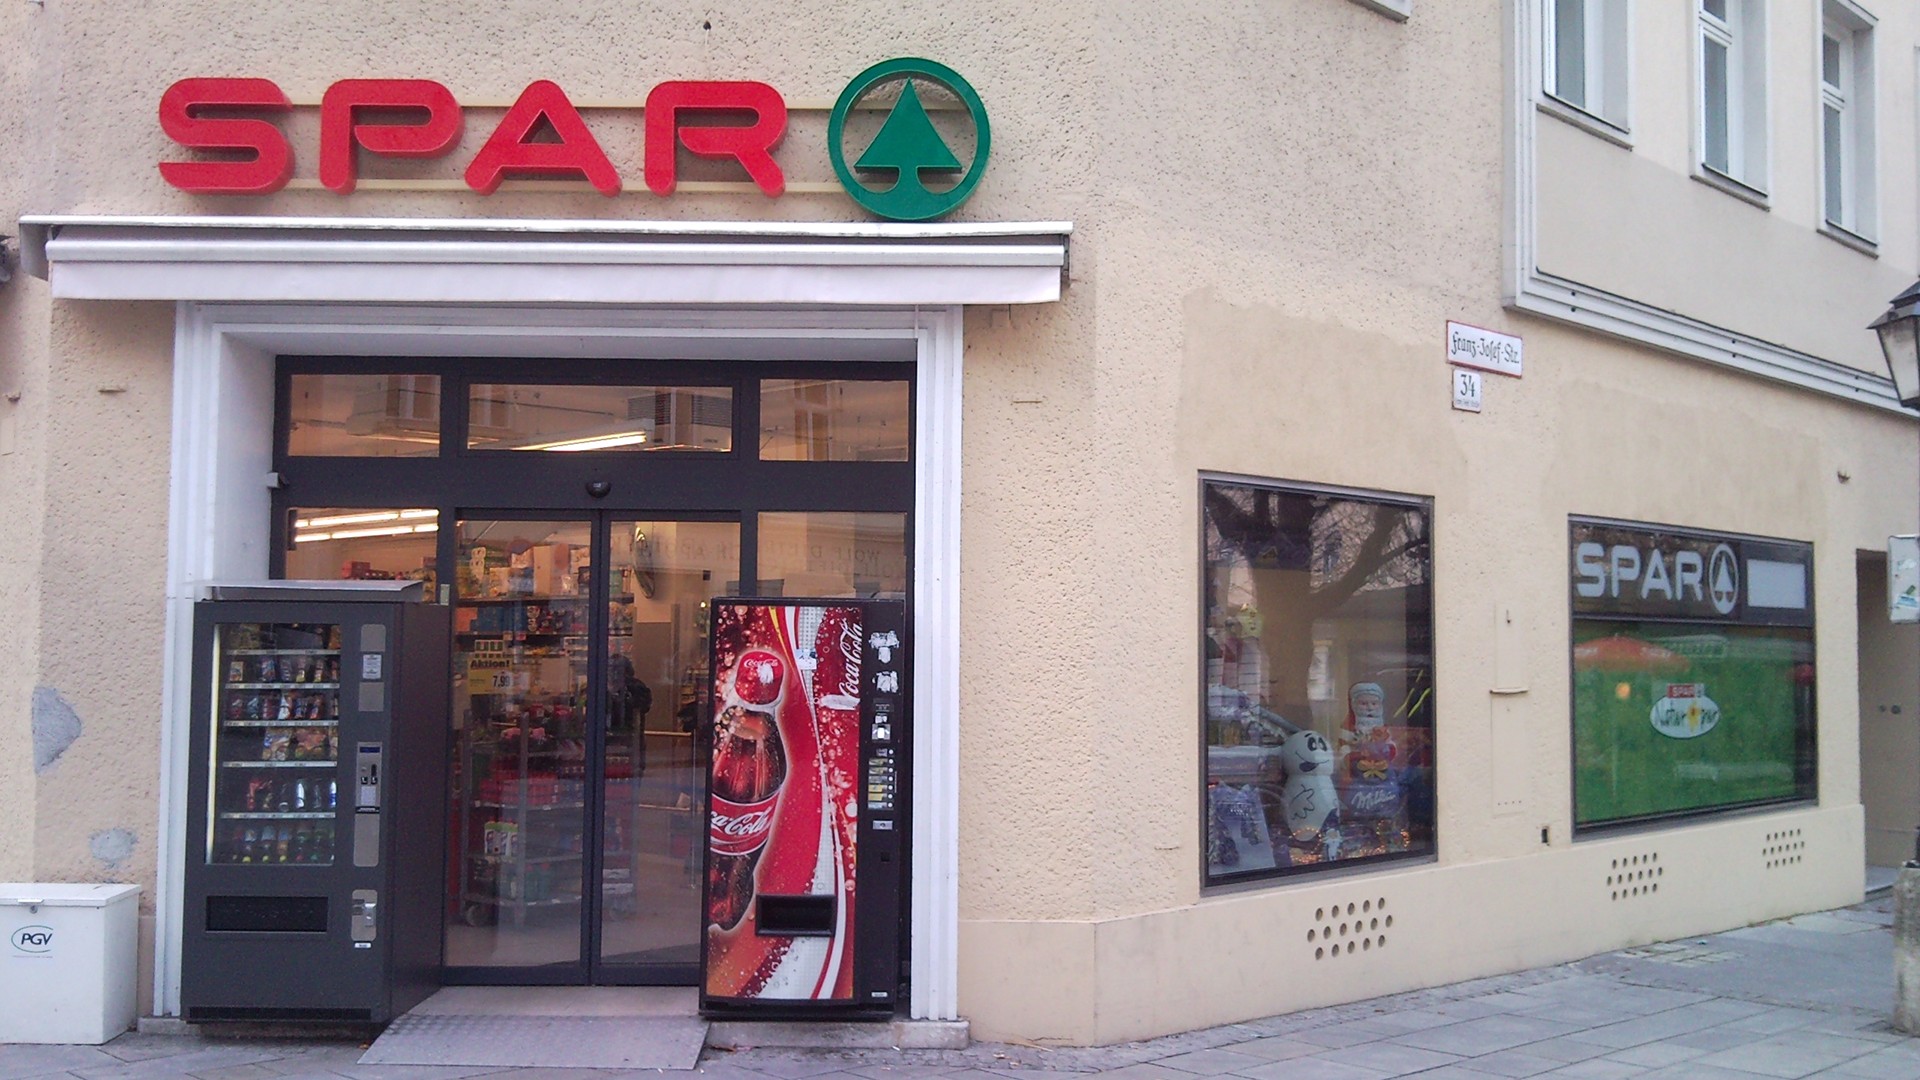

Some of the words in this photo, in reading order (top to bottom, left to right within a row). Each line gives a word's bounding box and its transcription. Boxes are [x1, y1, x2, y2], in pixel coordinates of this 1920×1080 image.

[158, 76, 787, 198] SPAR
[1460, 373, 1476, 397] 34
[1576, 542, 1704, 601] SPAR
[470, 660, 510, 669] Aktion!
[21, 933, 53, 945] PGV
